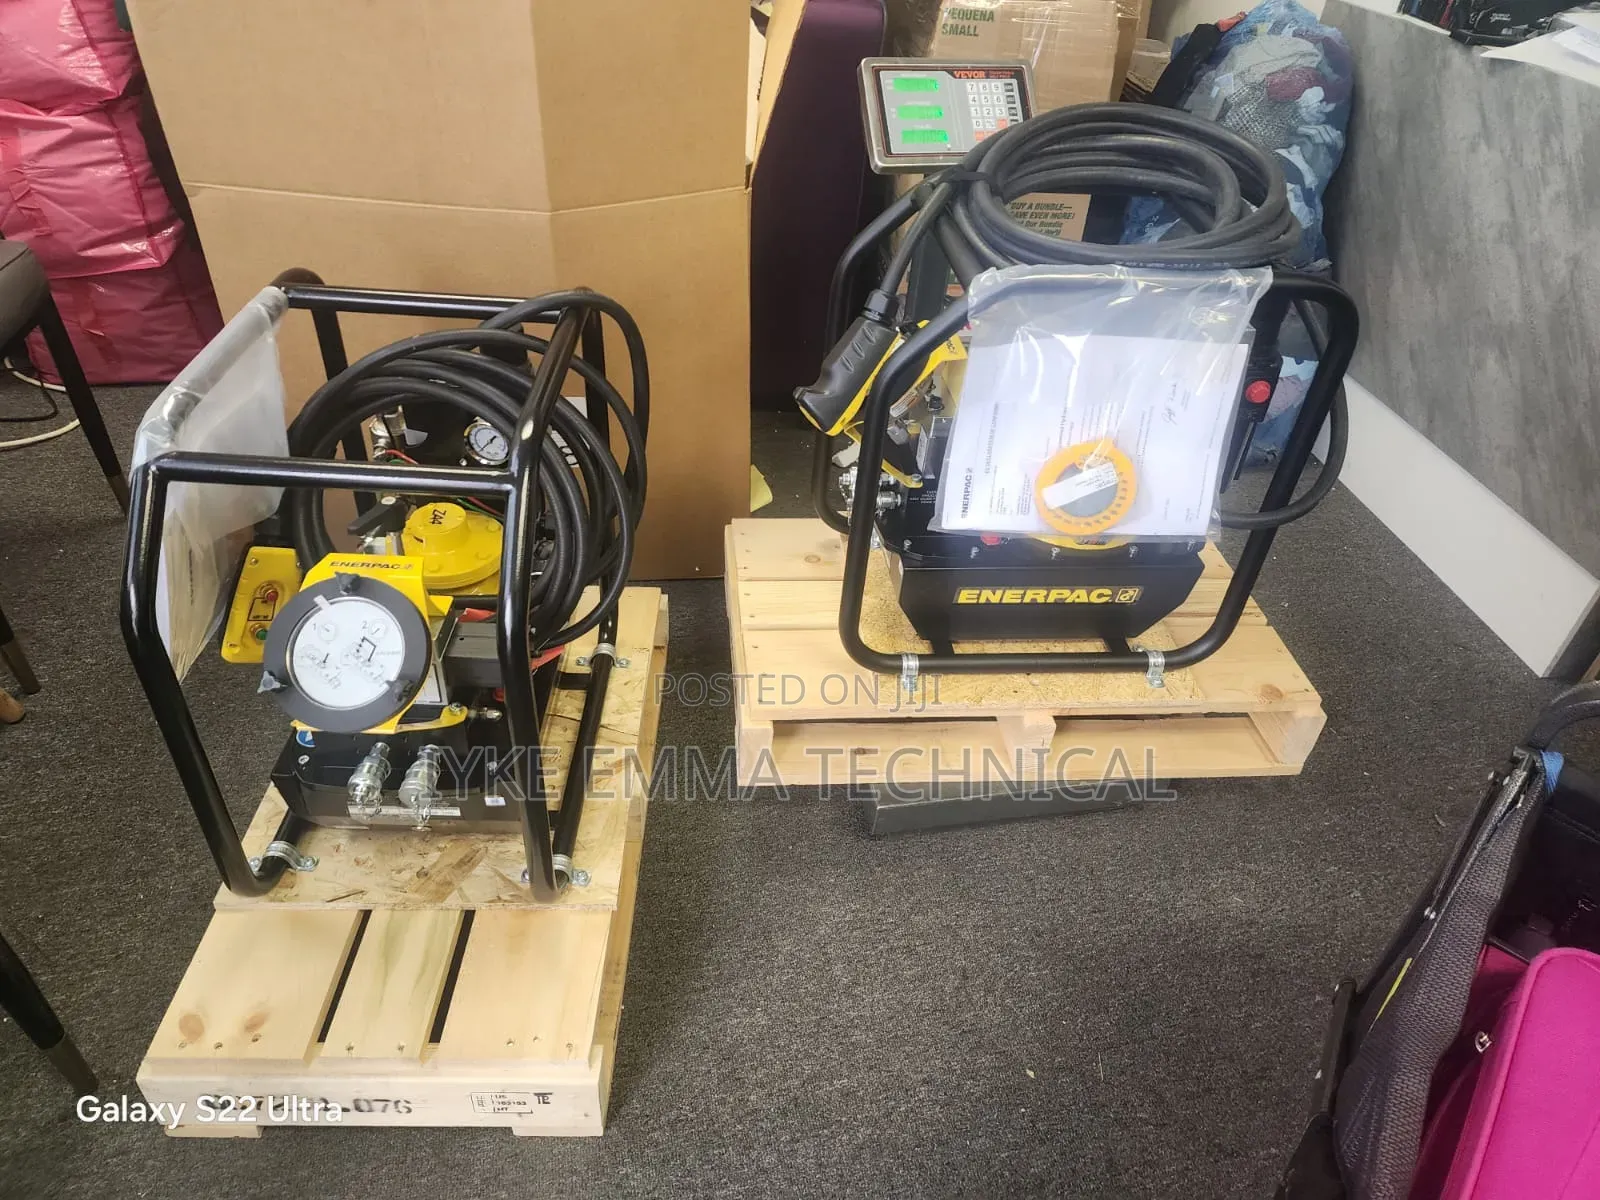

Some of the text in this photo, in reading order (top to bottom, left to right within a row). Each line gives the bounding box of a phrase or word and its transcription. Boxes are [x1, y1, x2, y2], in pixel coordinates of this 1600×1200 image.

[941, 23, 979, 37] SMALL
[1029, 211, 1049, 219] EVEN
[329, 561, 401, 570] ENERPAC
[957, 588, 1113, 604] ENERPAC
